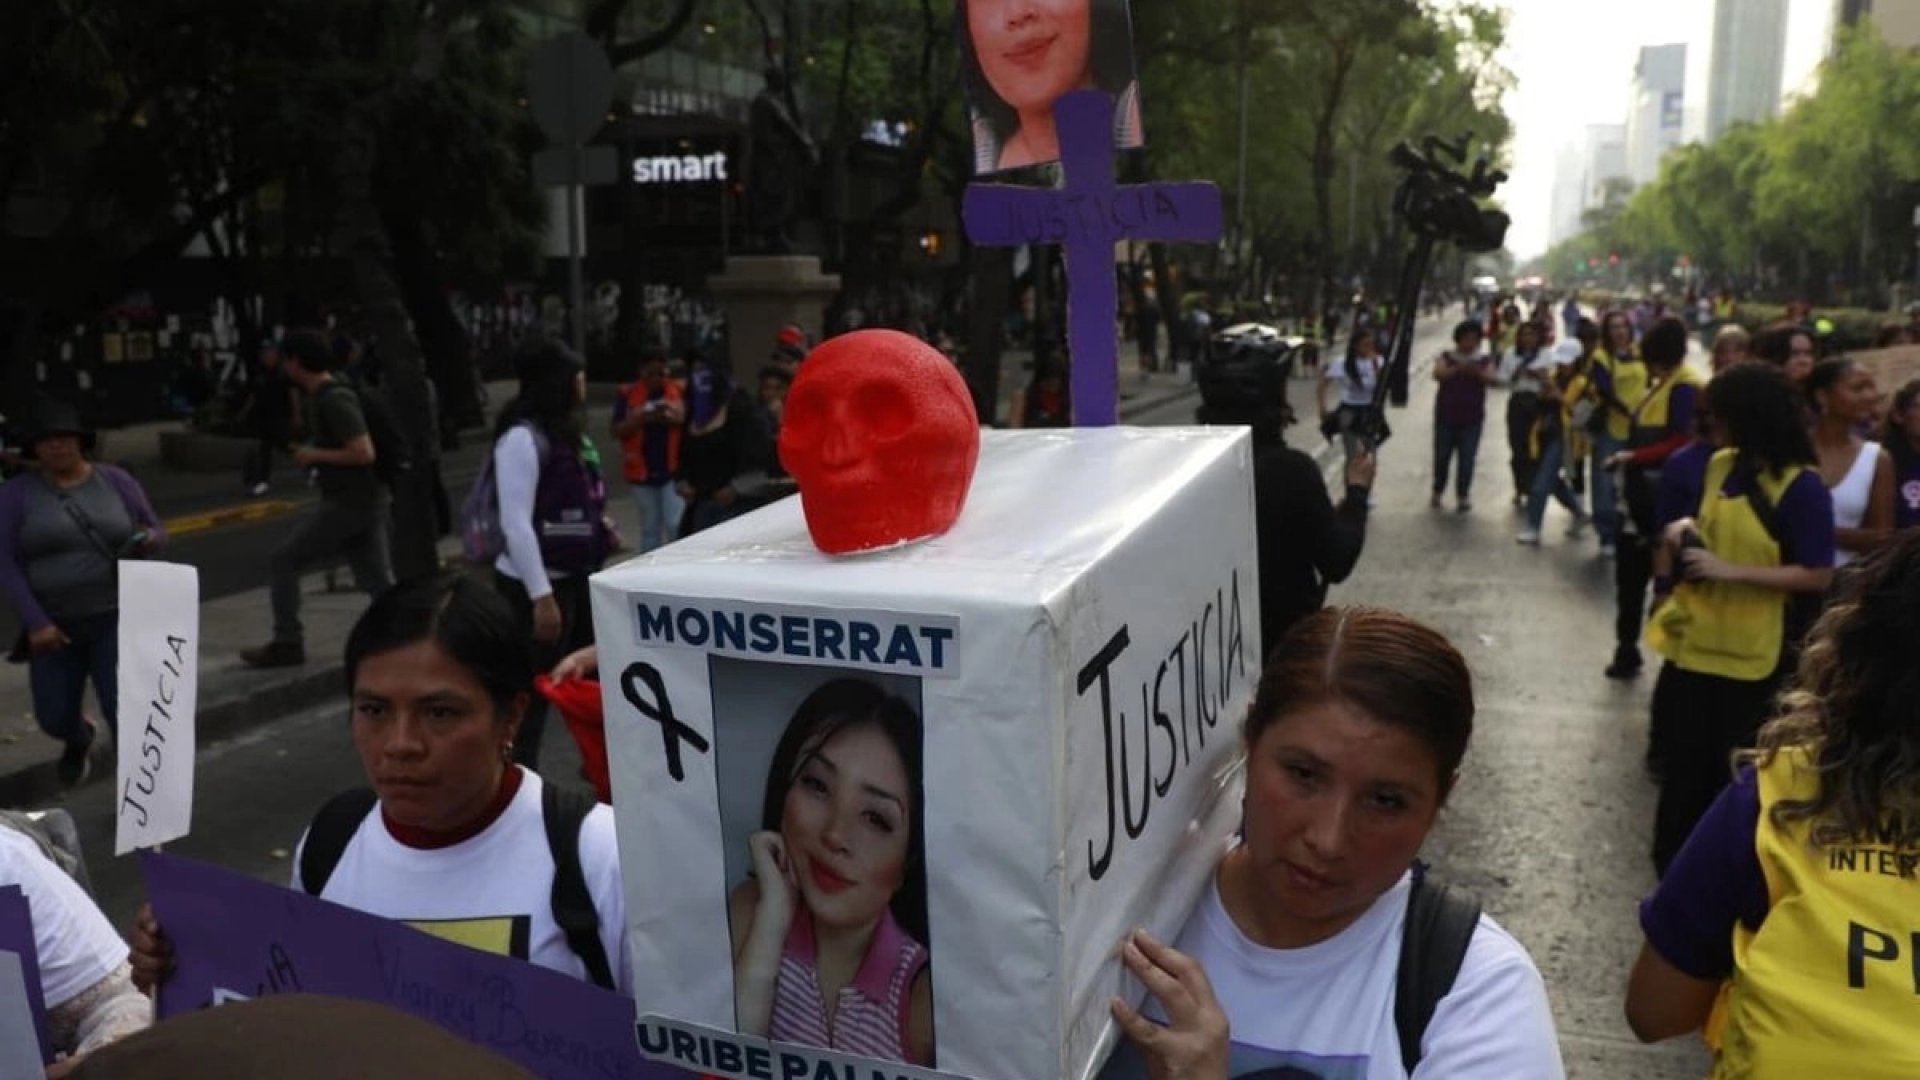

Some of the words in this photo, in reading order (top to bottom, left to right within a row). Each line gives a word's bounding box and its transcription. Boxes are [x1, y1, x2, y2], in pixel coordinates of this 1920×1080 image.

[632, 151, 728, 183] smart
[999, 190, 1179, 242] JUSTICIA
[637, 603, 953, 669] MONSERRAT
[120, 634, 188, 827] JUSTICIA
[1077, 568, 1245, 881] JUSTICIA
[637, 1023, 773, 1080] URIBE
